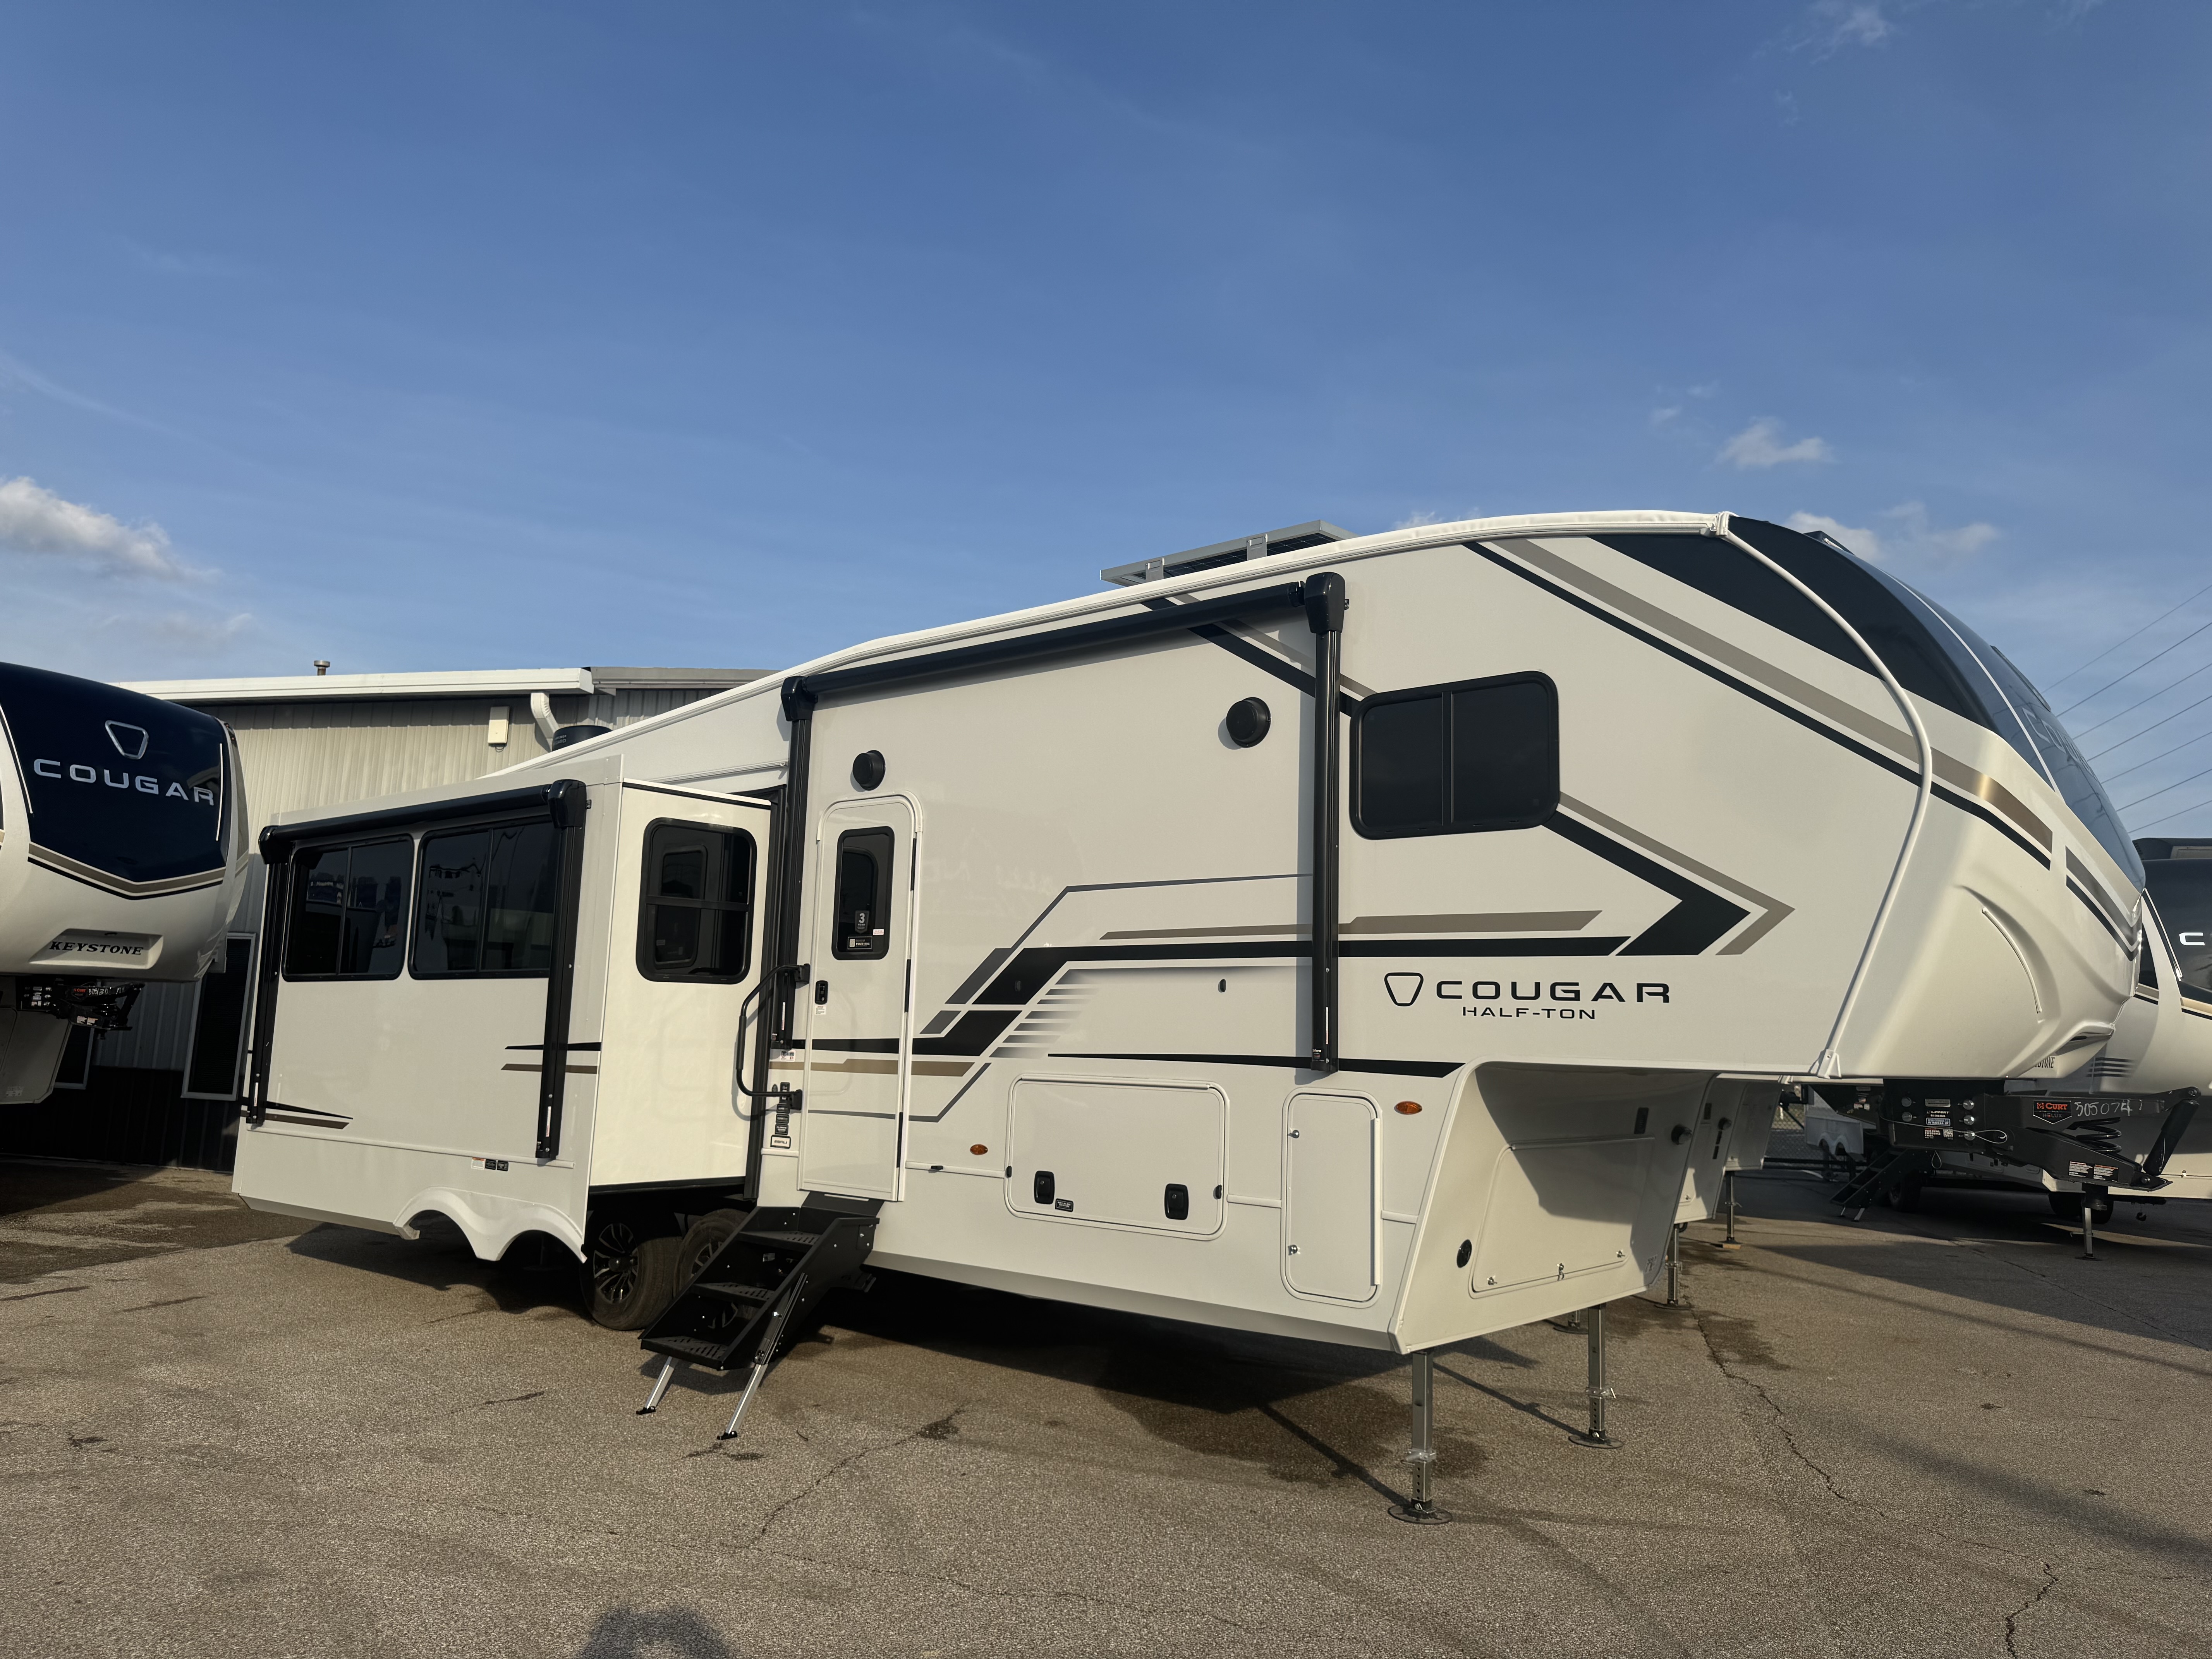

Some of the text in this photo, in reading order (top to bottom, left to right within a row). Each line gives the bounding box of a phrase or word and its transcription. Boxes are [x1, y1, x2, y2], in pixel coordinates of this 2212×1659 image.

[34, 758, 214, 806] COUGAR
[859, 913, 865, 923] 3
[49, 941, 143, 955] KEYSTONE
[1436, 981, 1669, 1003] COUGAR
[1463, 1006, 1595, 1019] HALF-TON
